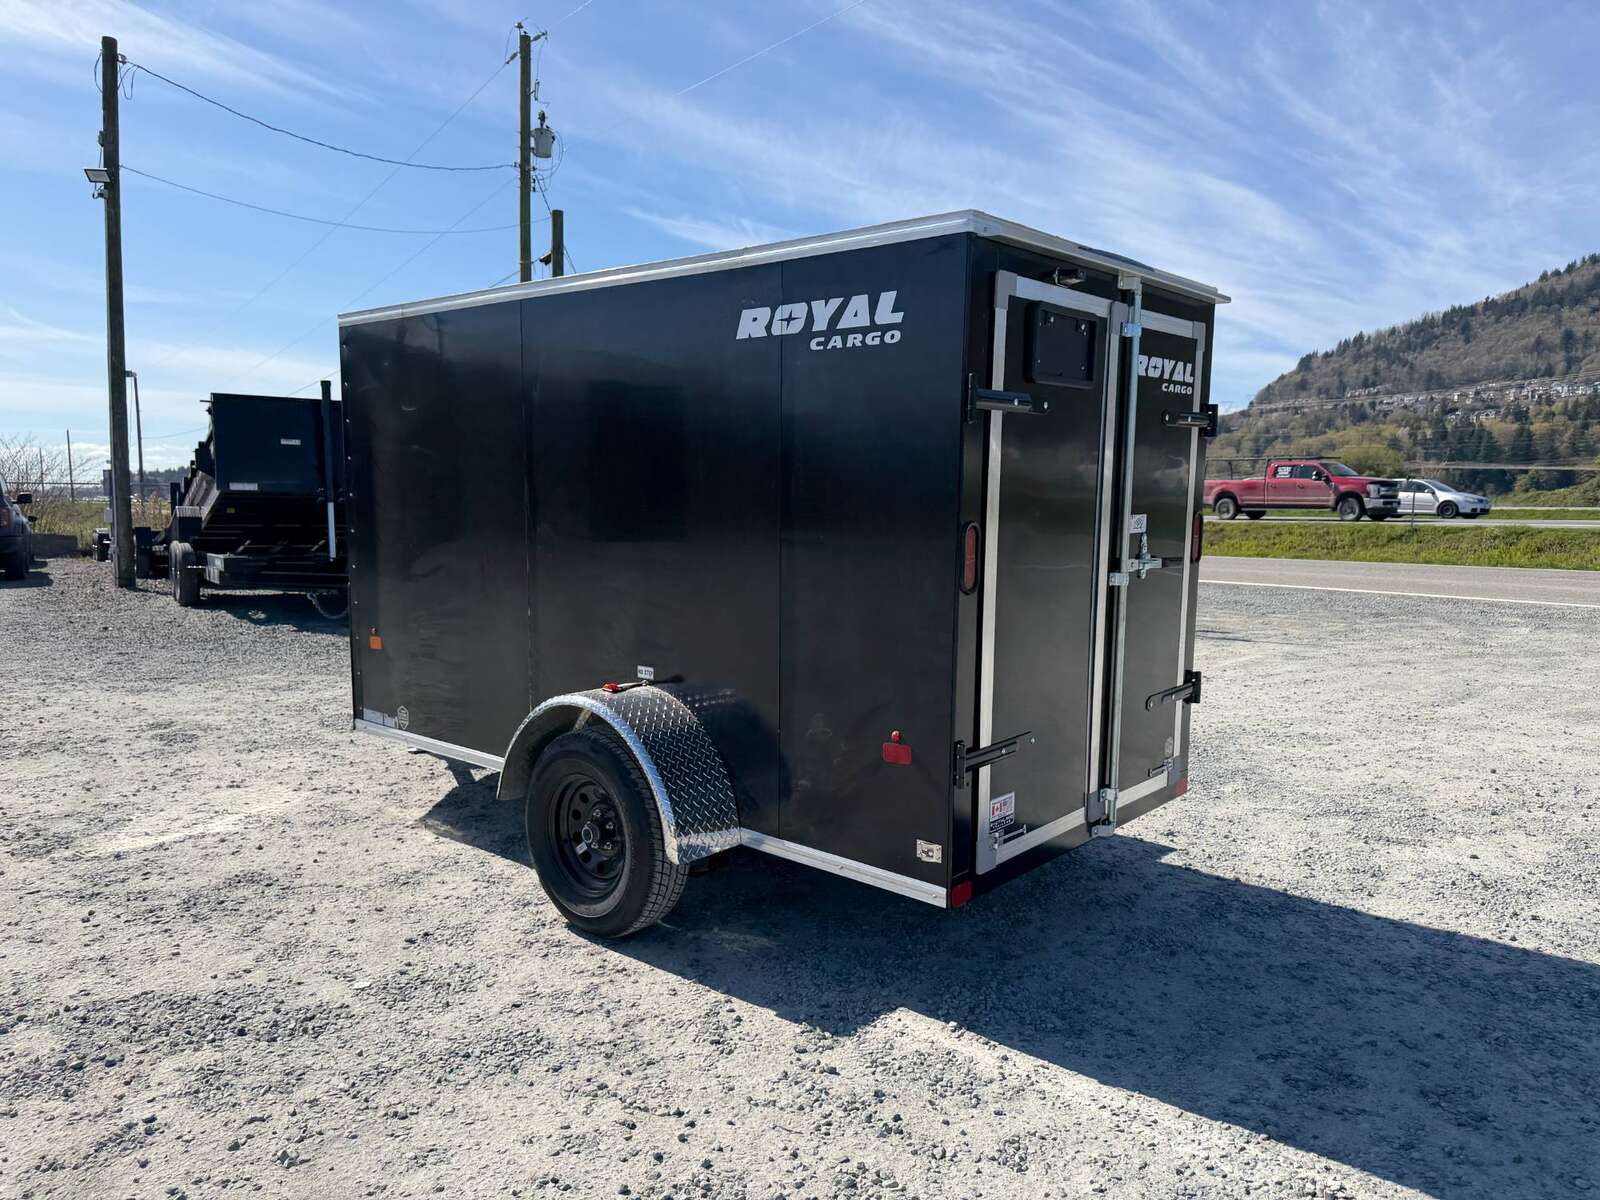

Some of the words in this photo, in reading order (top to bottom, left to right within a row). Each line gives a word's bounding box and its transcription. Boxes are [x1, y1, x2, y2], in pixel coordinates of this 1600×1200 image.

[736, 290, 904, 340] ROYAL
[810, 330, 902, 351] CARGO
[1138, 354, 1194, 383] ROYAL
[1161, 382, 1193, 395] CARGO
